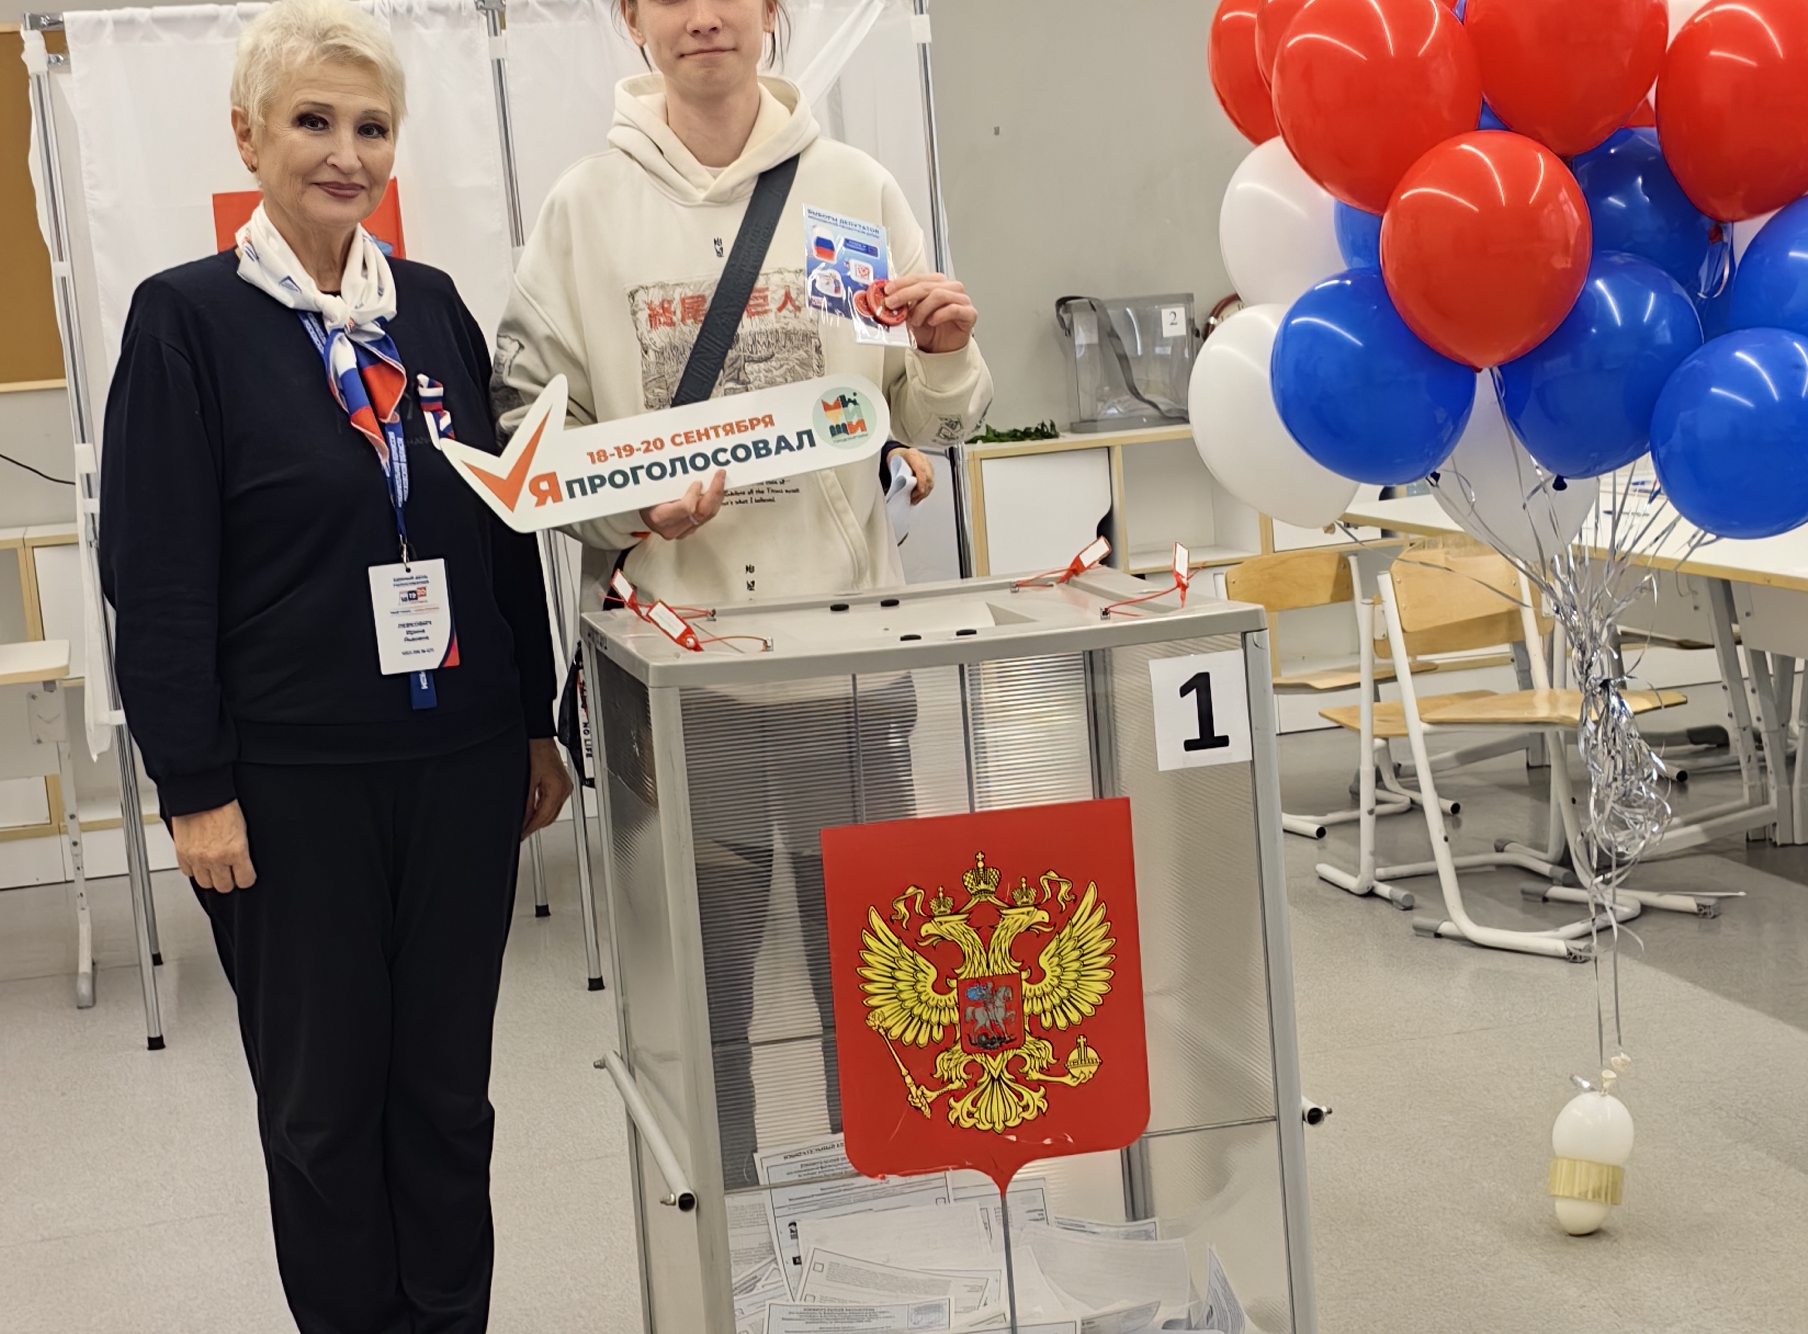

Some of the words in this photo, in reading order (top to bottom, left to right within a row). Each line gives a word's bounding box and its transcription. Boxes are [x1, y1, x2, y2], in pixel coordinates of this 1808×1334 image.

[1169, 310, 1178, 326] 2
[527, 472, 563, 508] Я
[566, 429, 816, 499] ПРОГОЛОСОВАЛ
[587, 438, 665, 464] 18-19-20
[669, 414, 775, 447] СЕНТЯБРЯ
[1179, 671, 1230, 752] 1
